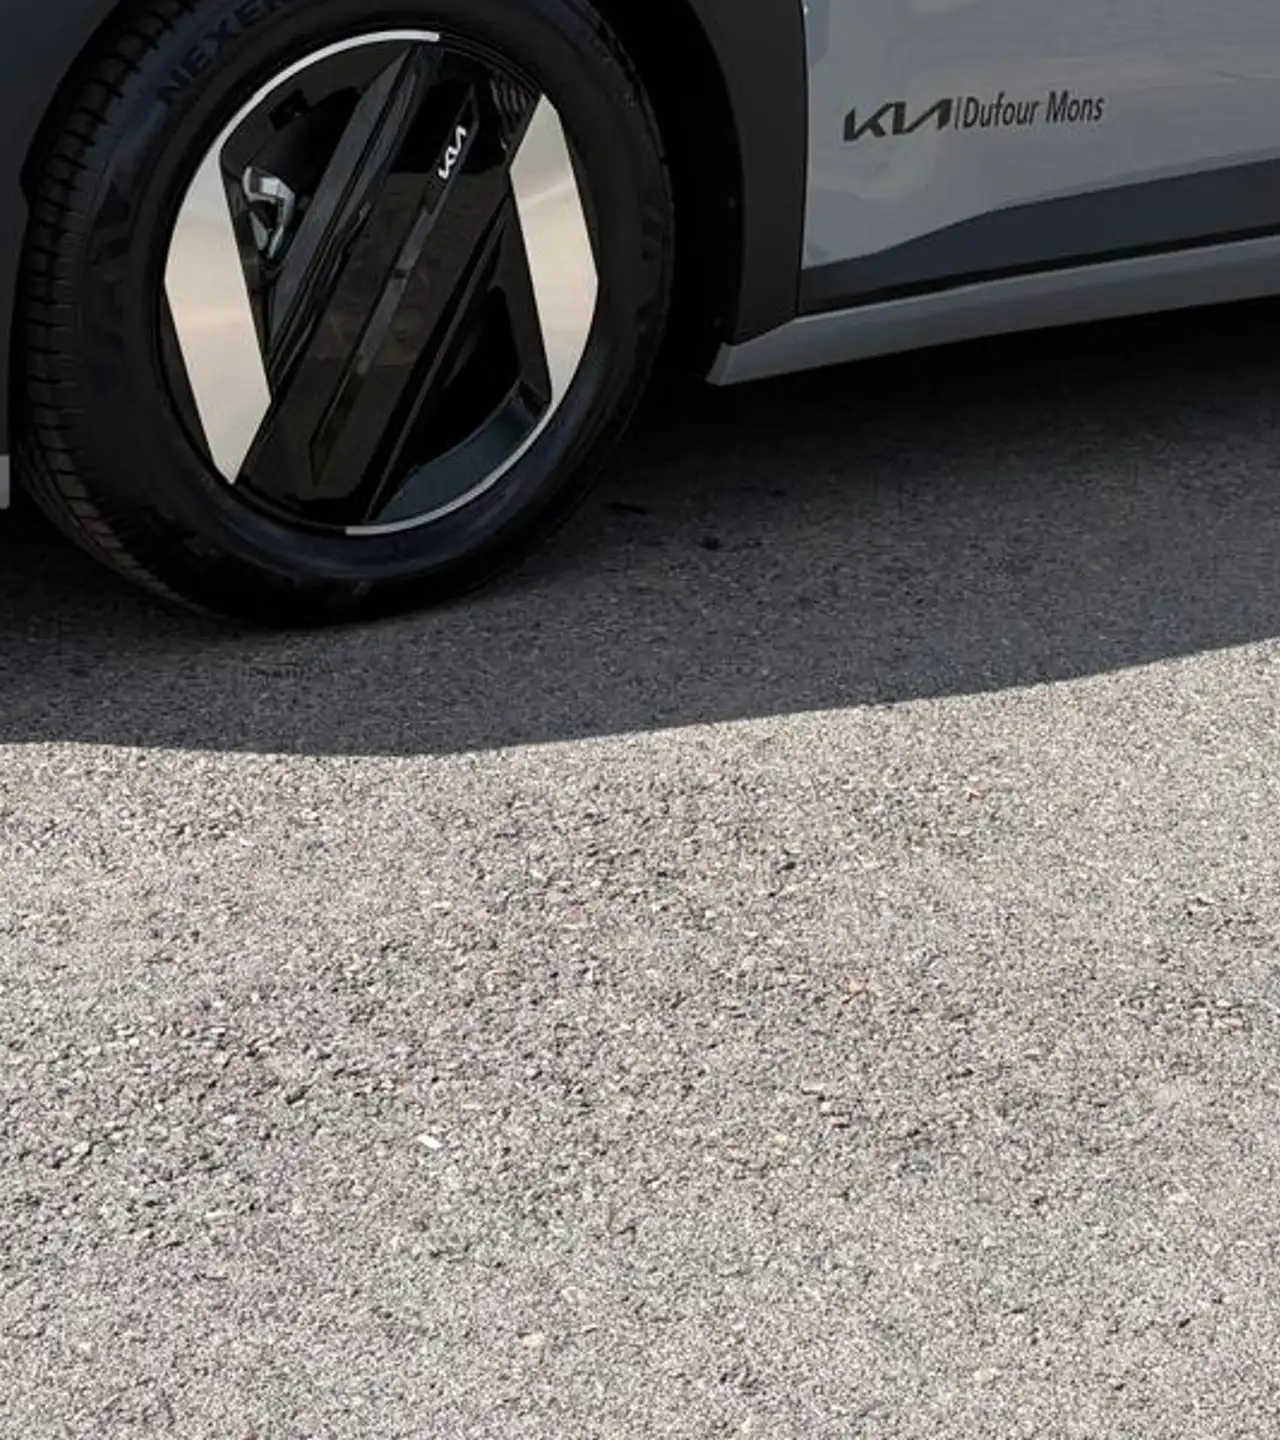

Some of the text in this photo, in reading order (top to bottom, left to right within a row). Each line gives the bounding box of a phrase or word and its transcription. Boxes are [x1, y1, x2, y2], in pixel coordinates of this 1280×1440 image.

[843, 89, 1106, 142] KIA Dufour Mons
